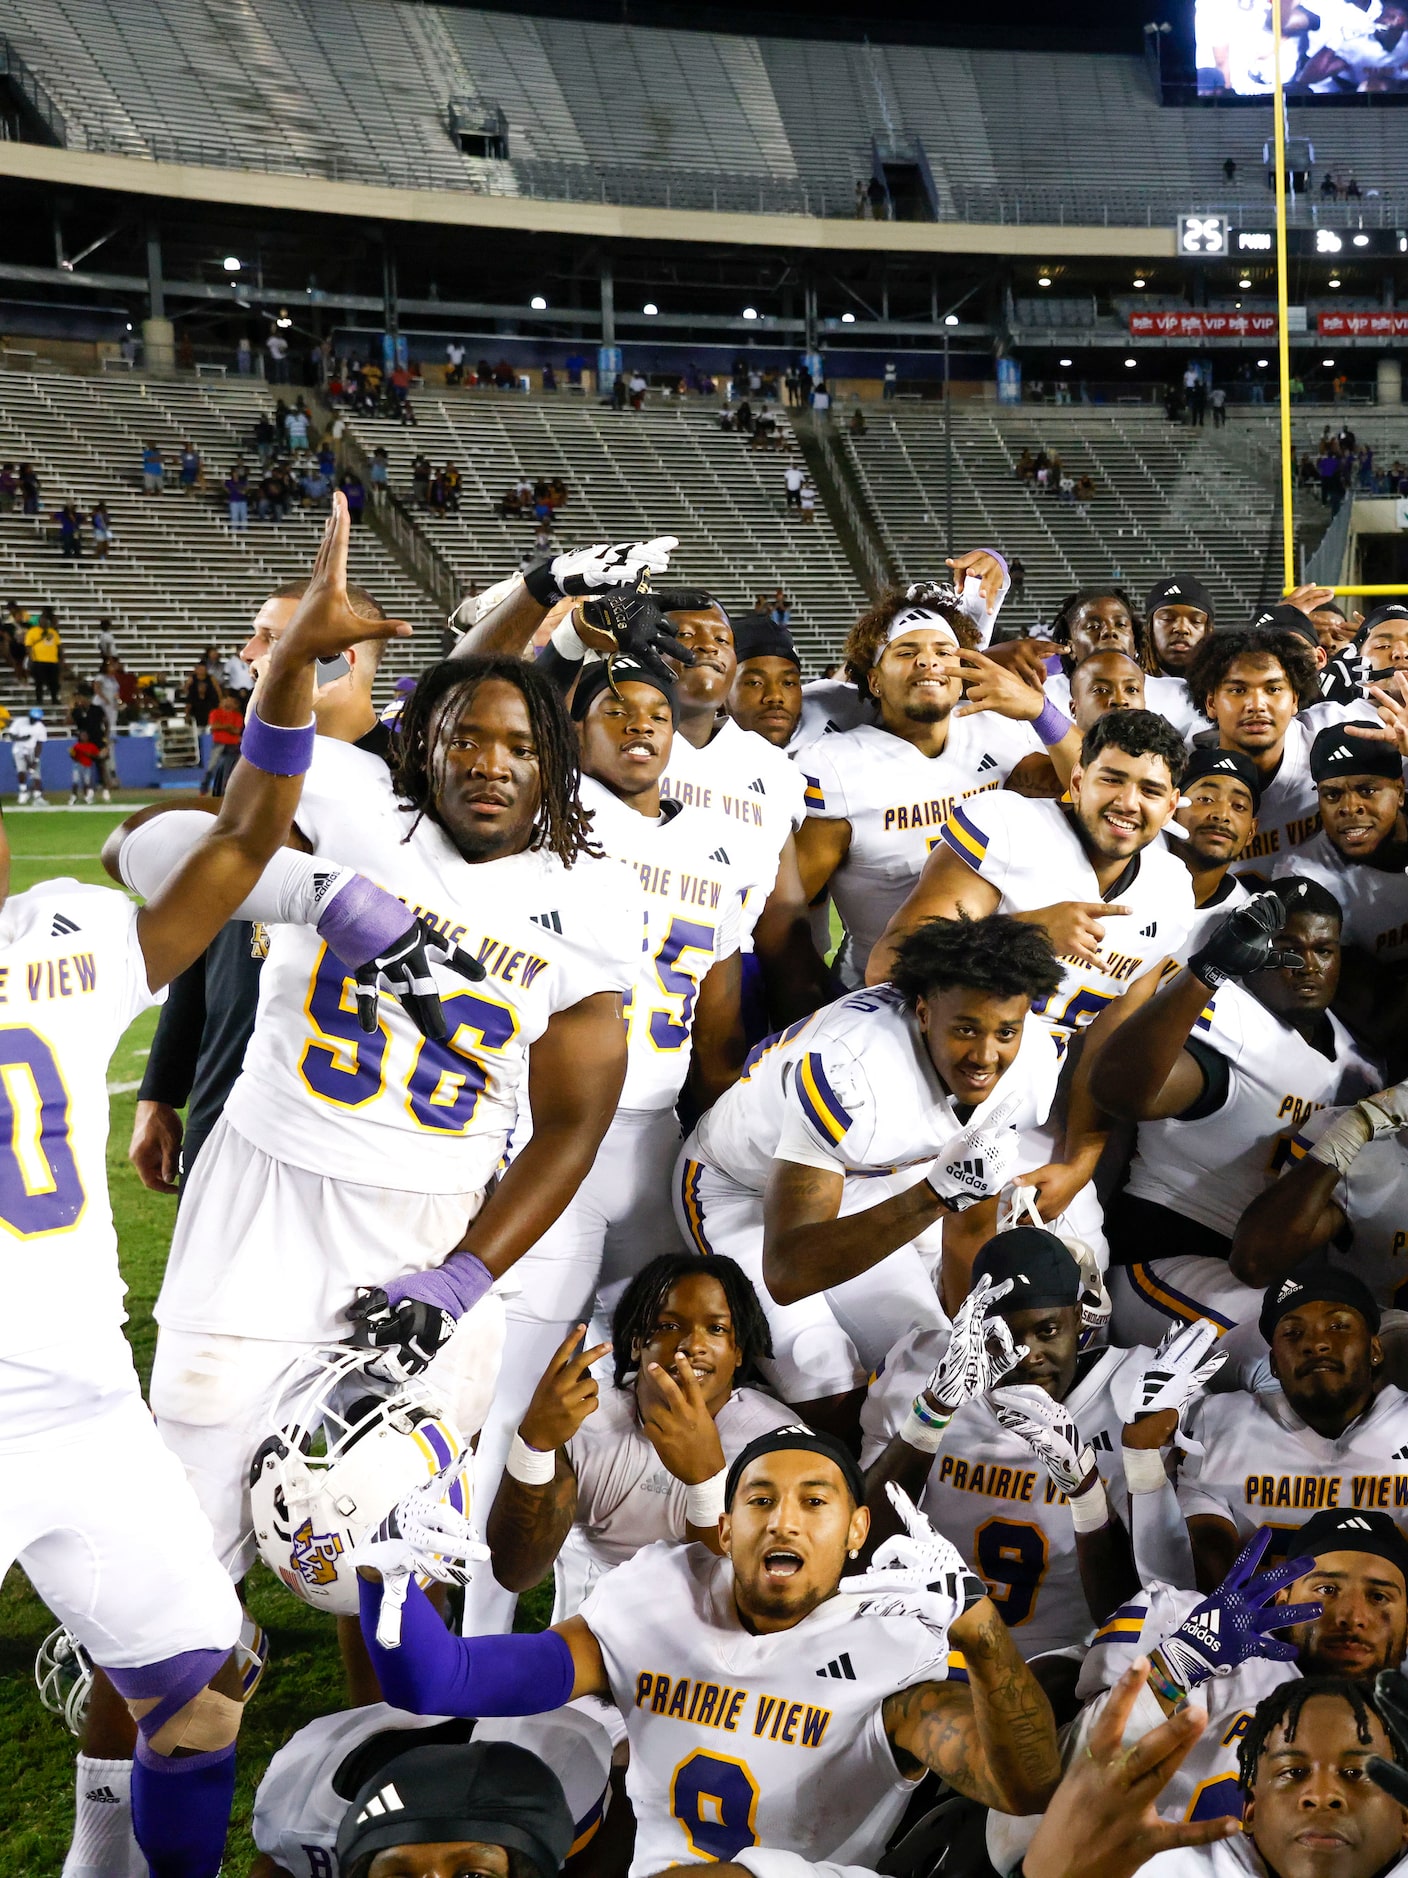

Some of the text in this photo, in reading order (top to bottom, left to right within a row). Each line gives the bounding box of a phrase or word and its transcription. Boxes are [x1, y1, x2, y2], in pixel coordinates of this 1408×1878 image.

[1183, 218, 1222, 251] 25
[1156, 318, 1178, 329] VIP
[1204, 318, 1226, 329] VIP
[1252, 318, 1274, 329] VIP
[1346, 318, 1368, 329] VIP
[722, 794, 762, 827] VIEW
[680, 873, 723, 911] VIEW
[27, 951, 97, 1003] VIEW
[475, 935, 550, 989] VIEW
[299, 940, 522, 1136] 56
[946, 1165, 988, 1191] adidas
[1277, 1284, 1304, 1303] adidas
[938, 1454, 1038, 1501] PRAIRIE
[1245, 1473, 1343, 1509] PRAIRIE
[973, 1515, 1050, 1627] 9
[1181, 1620, 1221, 1652] adidas
[635, 1669, 833, 1749] PRAIRIE VIEW
